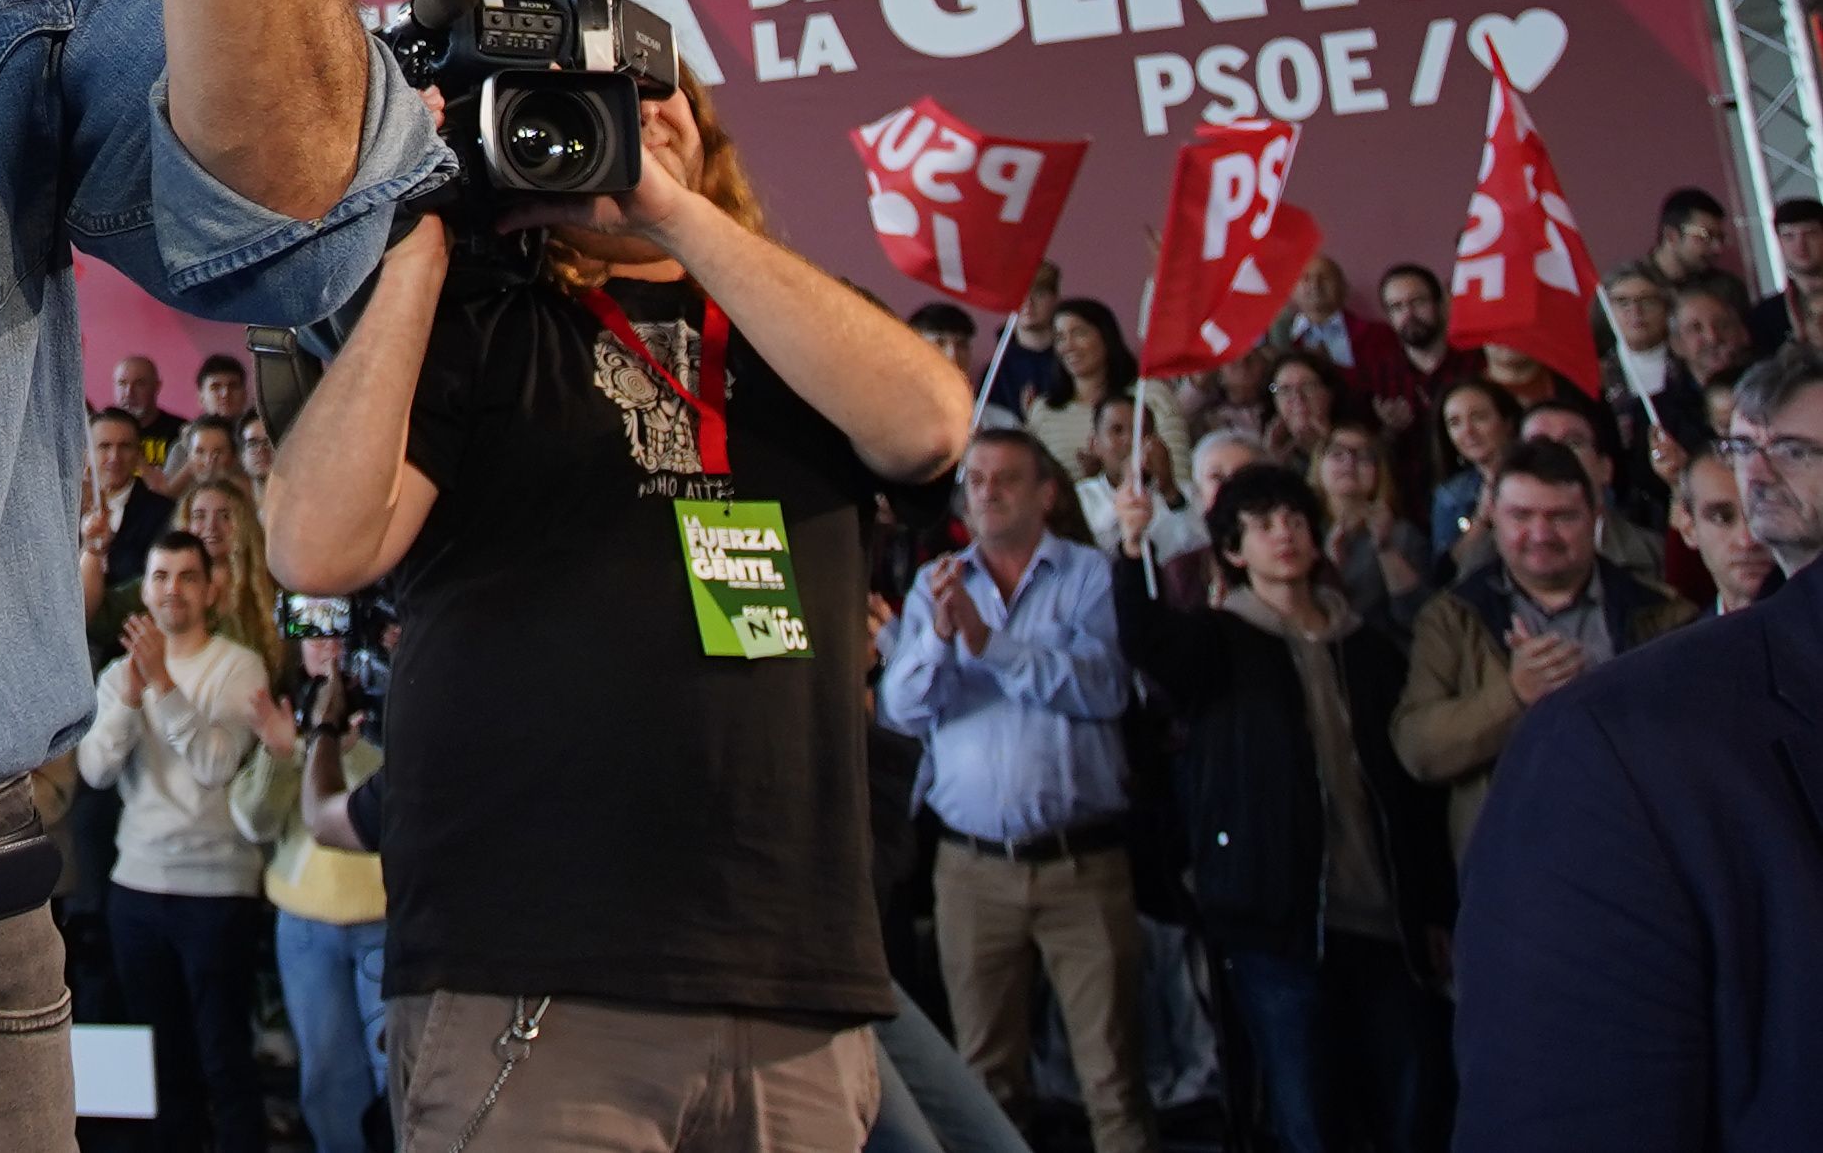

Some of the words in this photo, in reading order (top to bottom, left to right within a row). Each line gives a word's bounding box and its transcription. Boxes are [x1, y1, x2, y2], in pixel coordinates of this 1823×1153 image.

[752, 12, 858, 83] LA
[1134, 28, 1389, 136] PSOE
[685, 527, 783, 552] FUERZA
[691, 558, 783, 581] GENTE.
